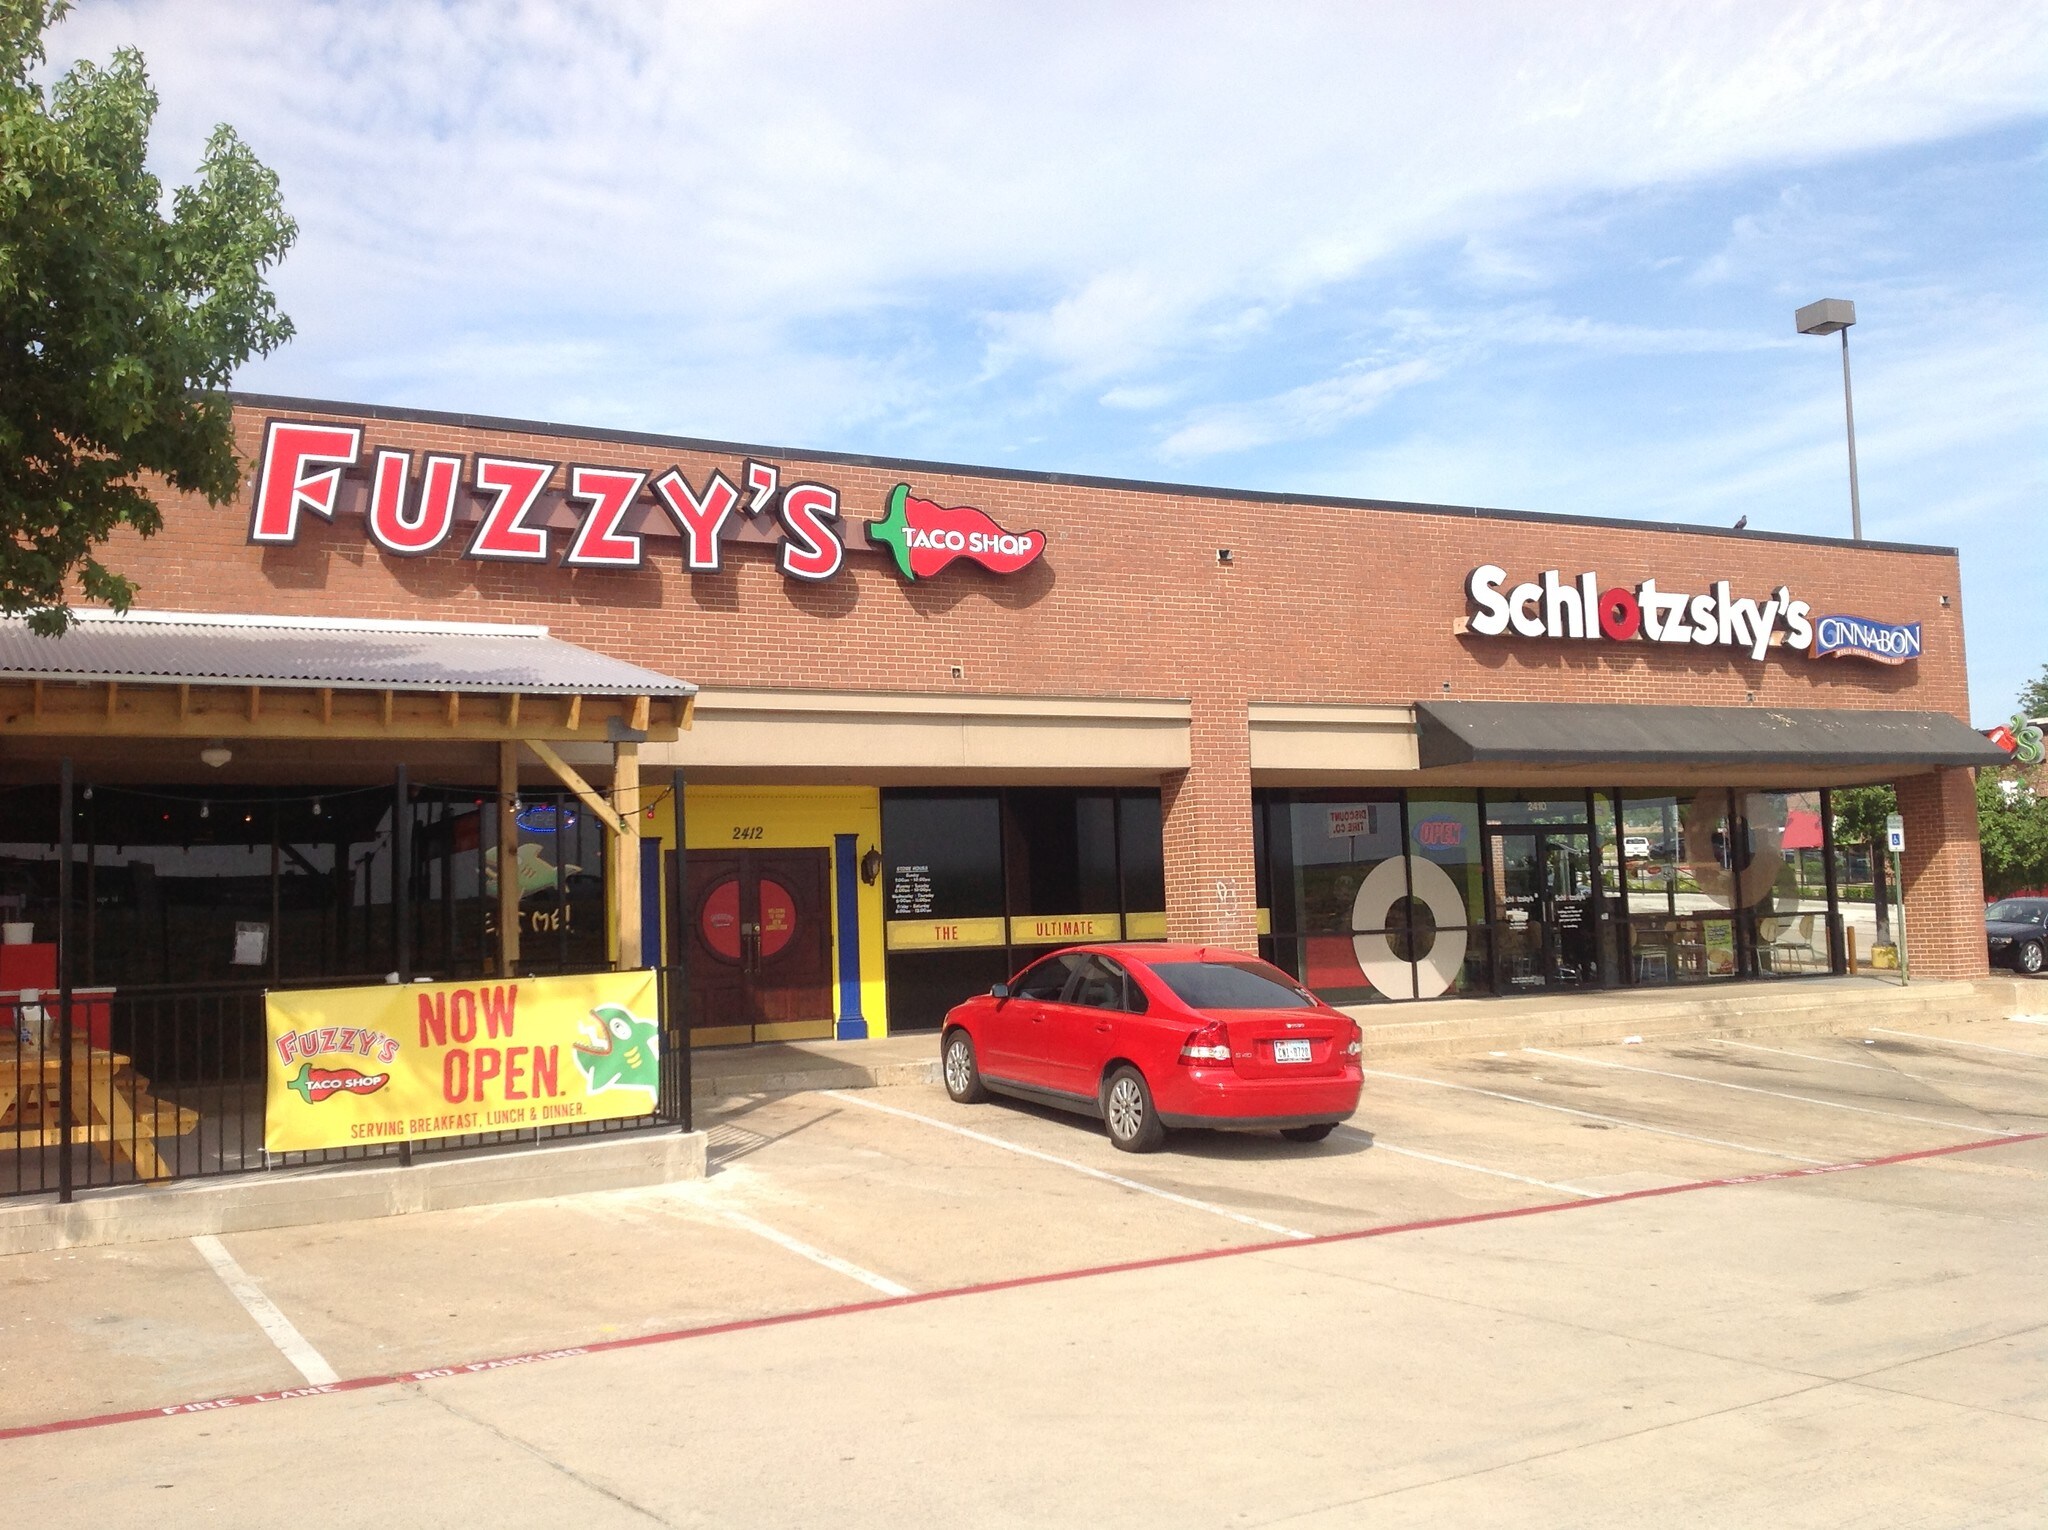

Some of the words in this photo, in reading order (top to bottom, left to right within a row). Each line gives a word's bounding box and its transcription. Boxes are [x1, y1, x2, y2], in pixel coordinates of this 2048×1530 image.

[251, 420, 842, 580] FUZZY'S
[902, 527, 963, 551] TACO
[969, 532, 1032, 556] SHOP
[1470, 564, 1812, 662] Schlotzsky's
[1818, 619, 1920, 654] CINNABON
[1528, 802, 1547, 811] 2410
[732, 826, 763, 840] 2412
[1420, 821, 1462, 845] OPEN
[935, 926, 958, 940] THE
[1036, 921, 1094, 936] ULTIMATE
[418, 984, 518, 1048] NOW
[275, 1026, 400, 1067] FUZZY'S
[304, 1079, 343, 1090] TACO
[345, 1076, 382, 1089] SHOP
[443, 1045, 566, 1104] OPEN.
[351, 1122, 404, 1139] SERVING
[410, 1113, 482, 1134] BREAKFAST,
[487, 1109, 525, 1124] LUNCH
[529, 1107, 537, 1121] &
[542, 1103, 586, 1119] DINNER.
[161, 1398, 240, 1415] FIRE
[254, 1384, 341, 1401] LANE
[412, 1368, 455, 1381] NO
[466, 1348, 589, 1372] PARKING
